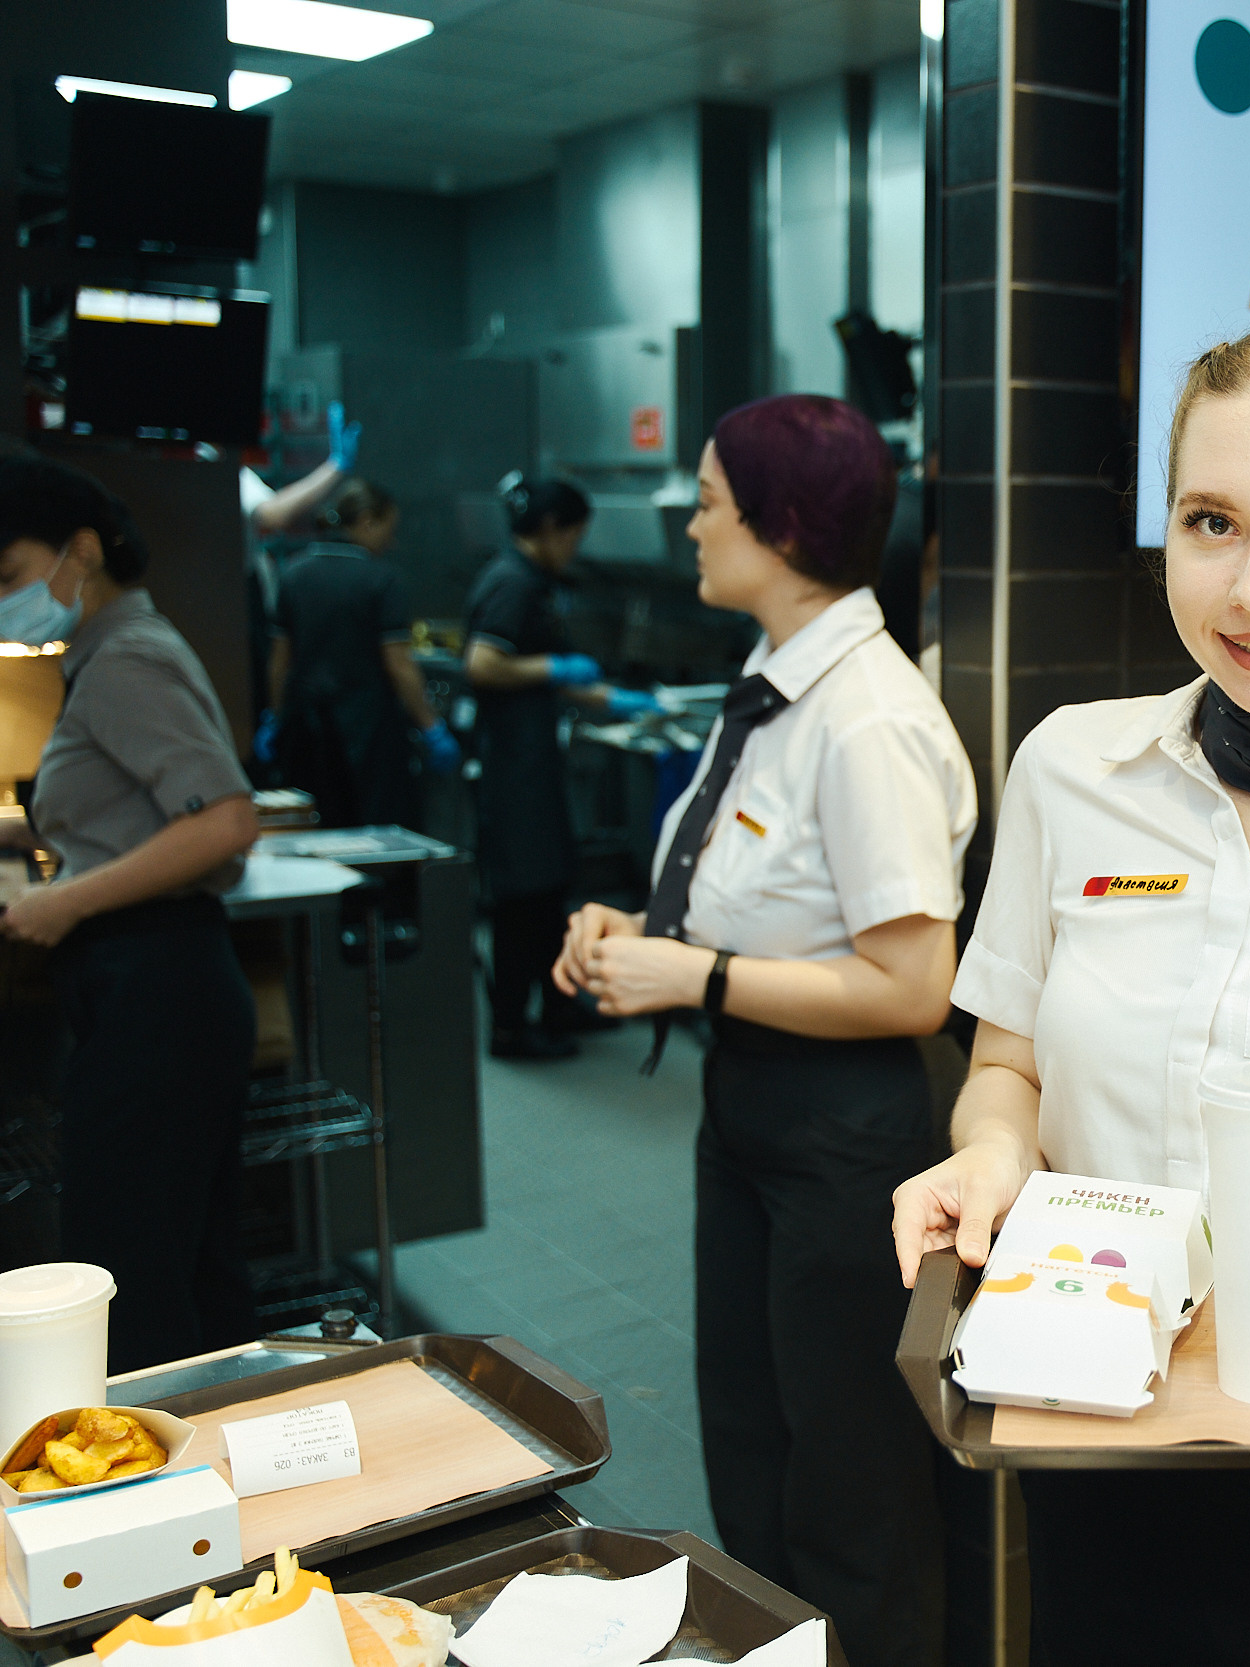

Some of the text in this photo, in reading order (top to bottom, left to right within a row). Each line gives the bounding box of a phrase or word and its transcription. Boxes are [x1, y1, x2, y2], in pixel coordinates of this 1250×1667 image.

[1072, 1189, 1151, 1205] ЧИКЕН
[1048, 1196, 1165, 1217] ПРЕМЬЕР
[1054, 1279, 1084, 1293] 6
[274, 1460, 292, 1471] 026
